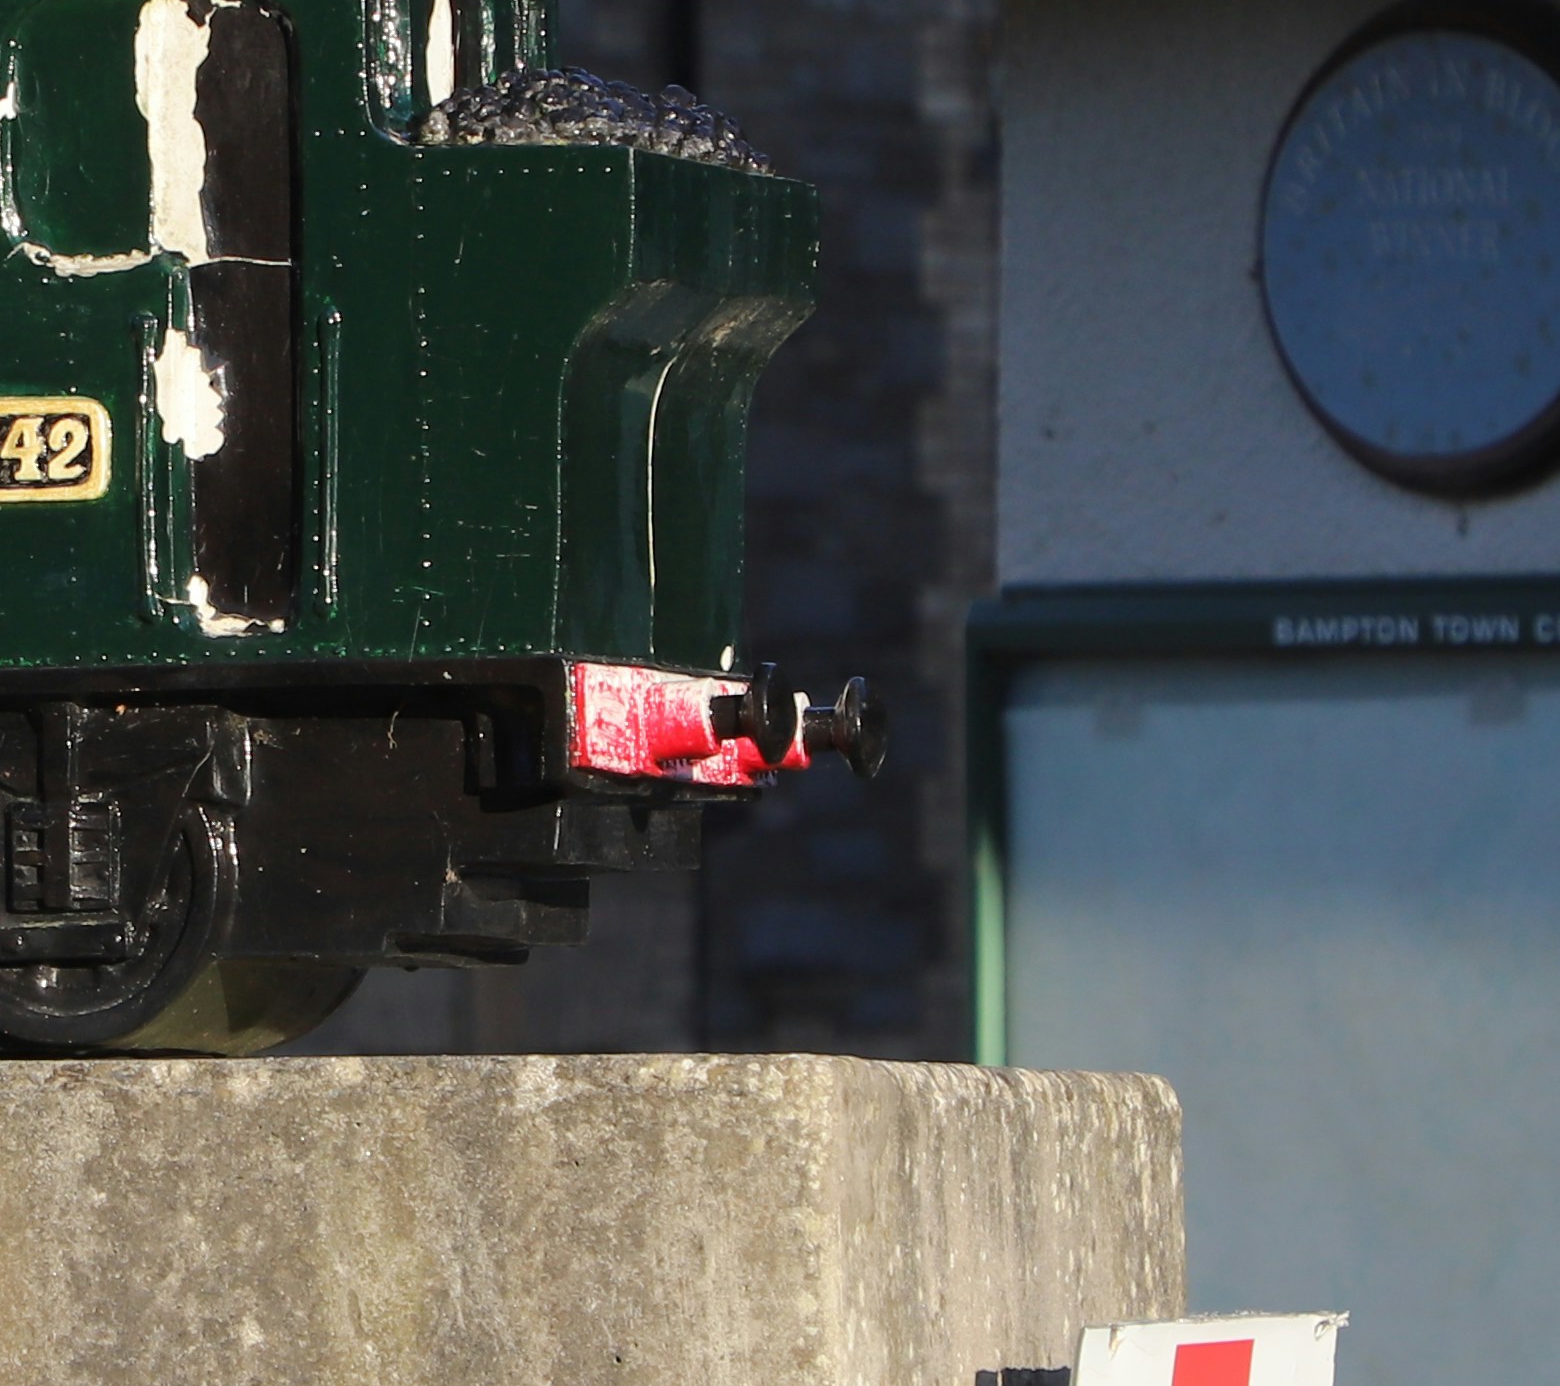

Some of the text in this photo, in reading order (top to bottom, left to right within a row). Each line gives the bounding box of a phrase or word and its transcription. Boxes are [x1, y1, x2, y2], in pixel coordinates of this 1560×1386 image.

[1279, 65, 1411, 217] BRITAIN
[1428, 58, 1469, 98] IN
[1355, 165, 1509, 208] NATIONAL
[1273, 615, 1419, 646] BAMPTON
[1433, 615, 1520, 644] TOWN
